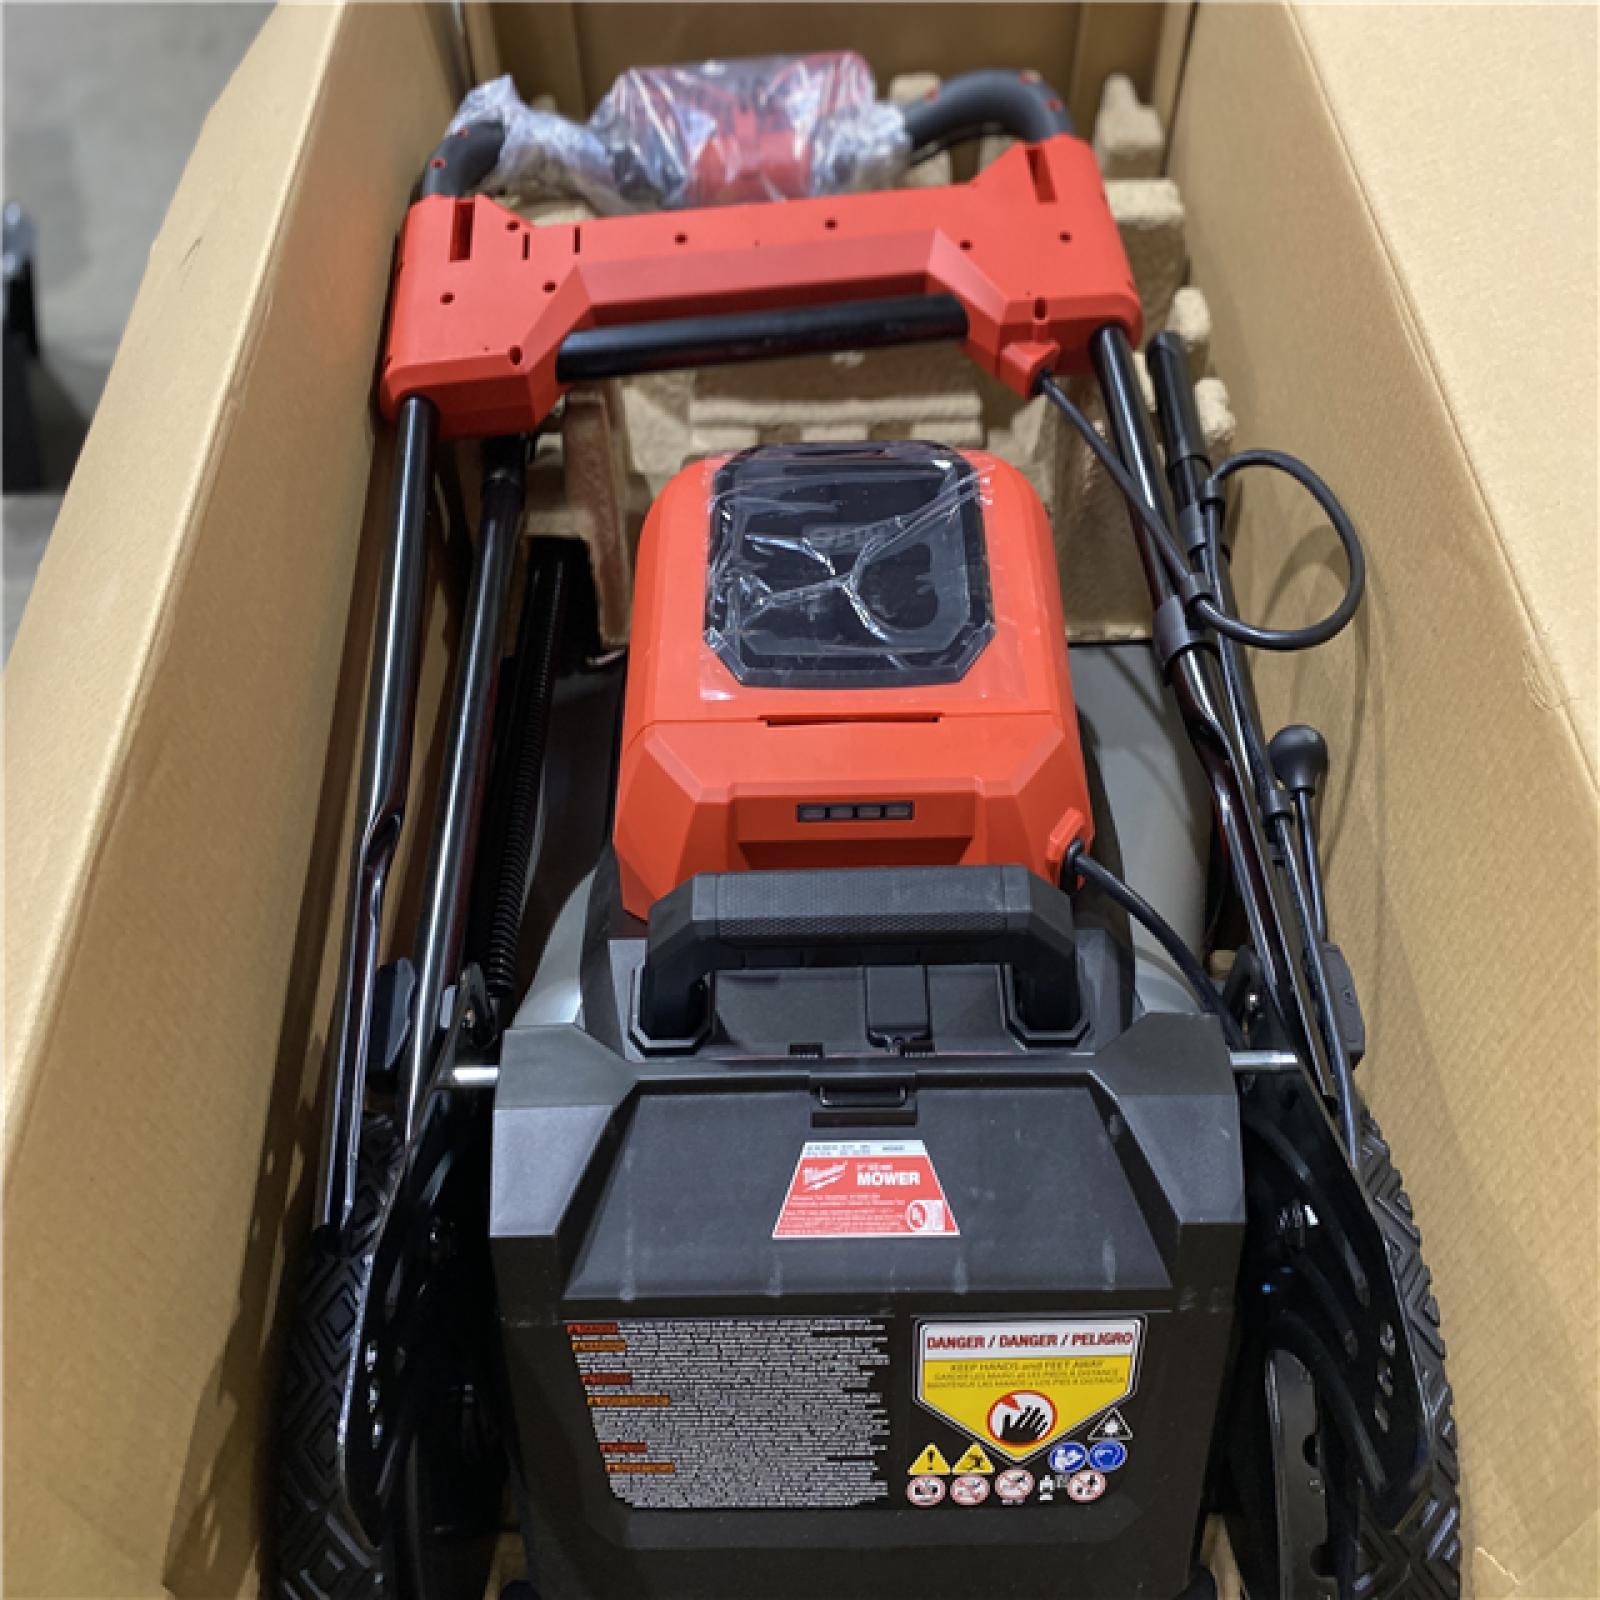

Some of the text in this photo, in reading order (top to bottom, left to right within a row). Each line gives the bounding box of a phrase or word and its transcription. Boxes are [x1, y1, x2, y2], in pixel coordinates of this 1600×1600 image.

[857, 1171, 921, 1186] MOWER
[927, 1336, 985, 1350] DANGER
[1000, 1334, 1058, 1348] DANGER
[1072, 1332, 1133, 1346] PELIGRO
[950, 1363, 978, 1372] KEEP
[980, 1362, 1018, 1371] HANDS
[1044, 1360, 1070, 1369] FEET
[1072, 1358, 1104, 1367] AWAY
